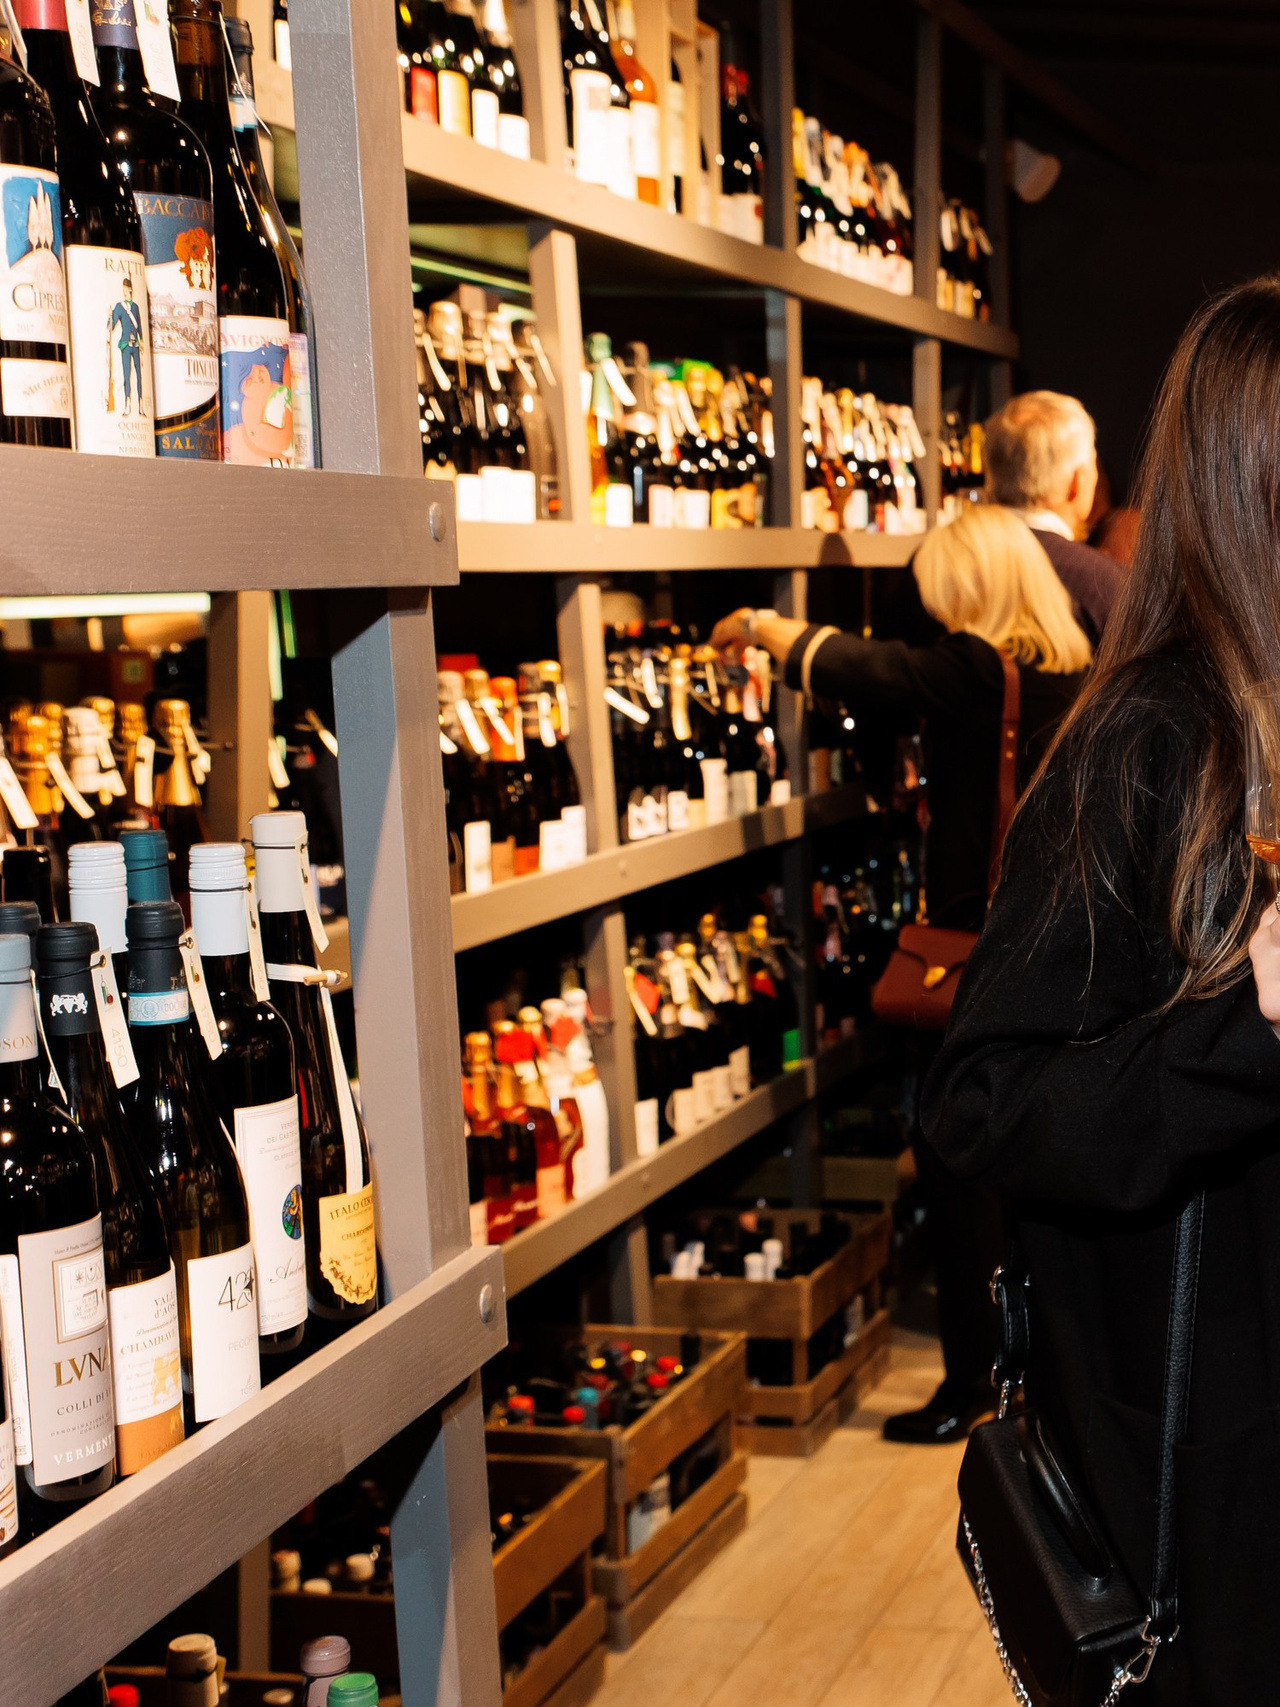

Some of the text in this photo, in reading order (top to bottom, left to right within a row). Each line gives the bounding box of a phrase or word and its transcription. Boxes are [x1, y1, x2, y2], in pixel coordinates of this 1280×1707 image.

[104, 257, 143, 277] RATTI
[111, 1028, 128, 1067] 4150
[329, 1200, 360, 1220] ITALO
[56, 1397, 93, 1417] COLLI
